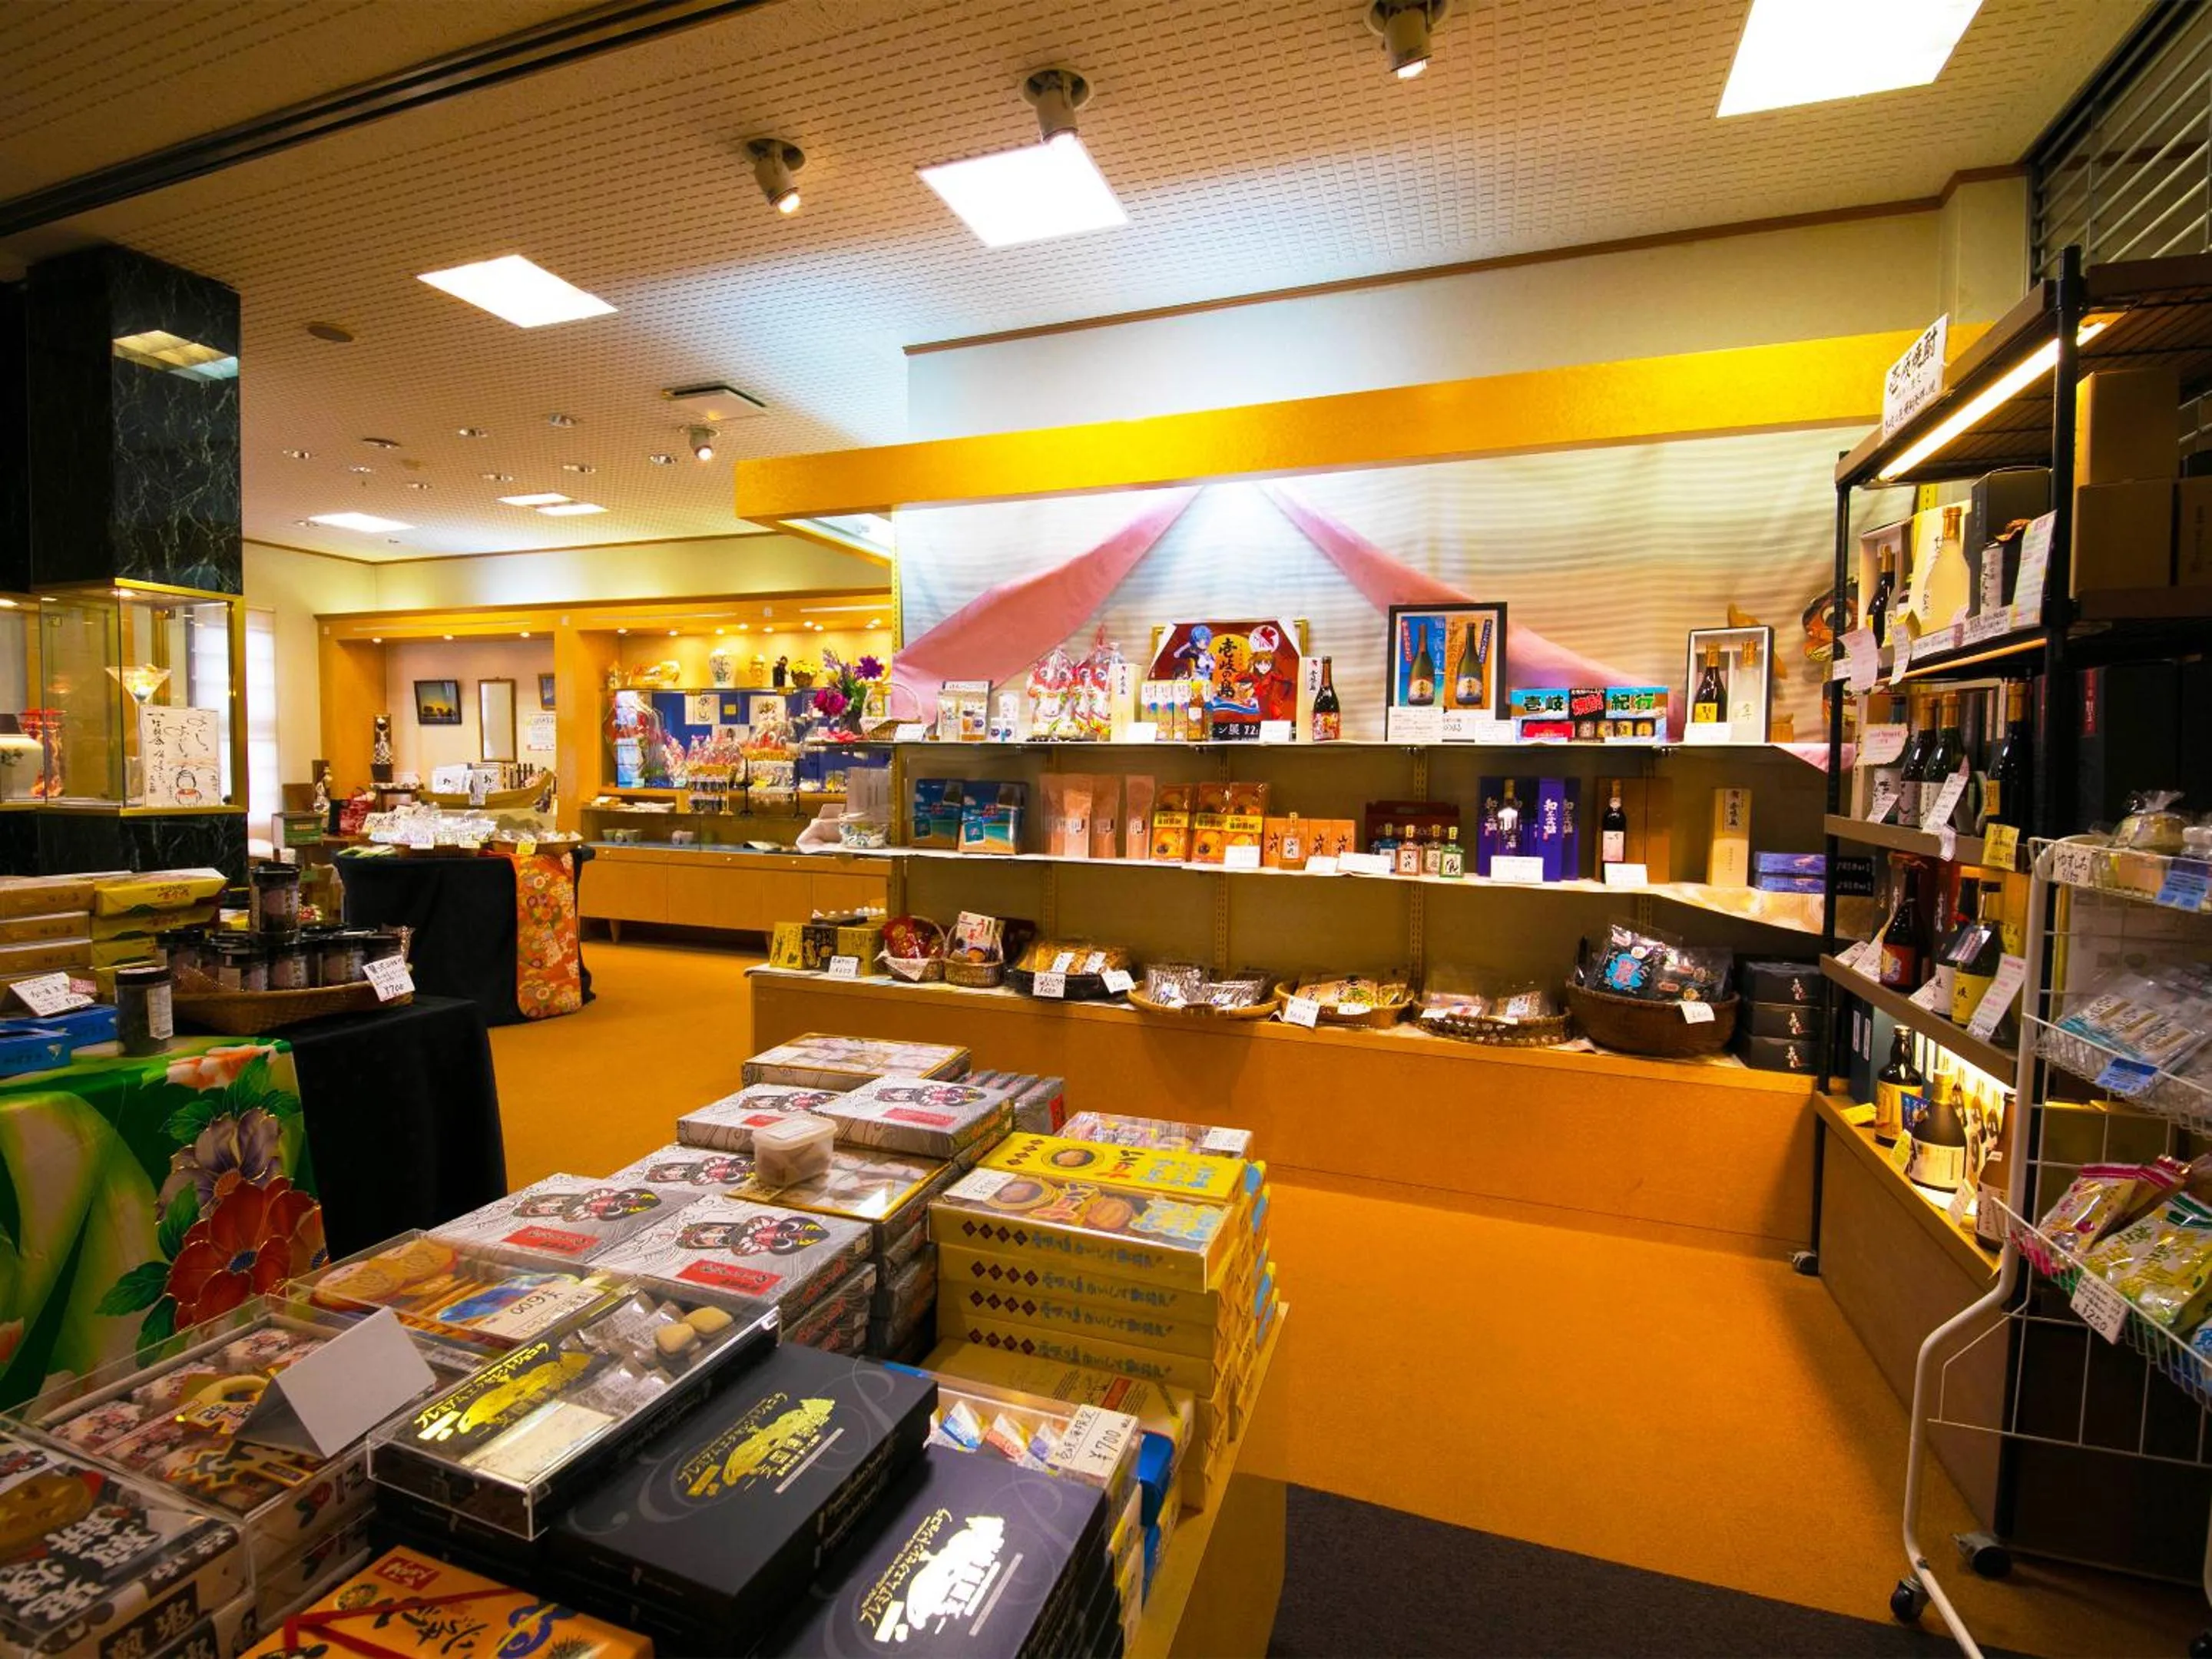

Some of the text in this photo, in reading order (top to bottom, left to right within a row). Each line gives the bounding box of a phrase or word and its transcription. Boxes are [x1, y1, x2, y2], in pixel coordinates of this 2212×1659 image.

[1524, 694, 1564, 711] 壱岐
[1611, 693, 1655, 710] 紀行
[859, 1508, 953, 1627] プレミアムエクセレントショコラ
